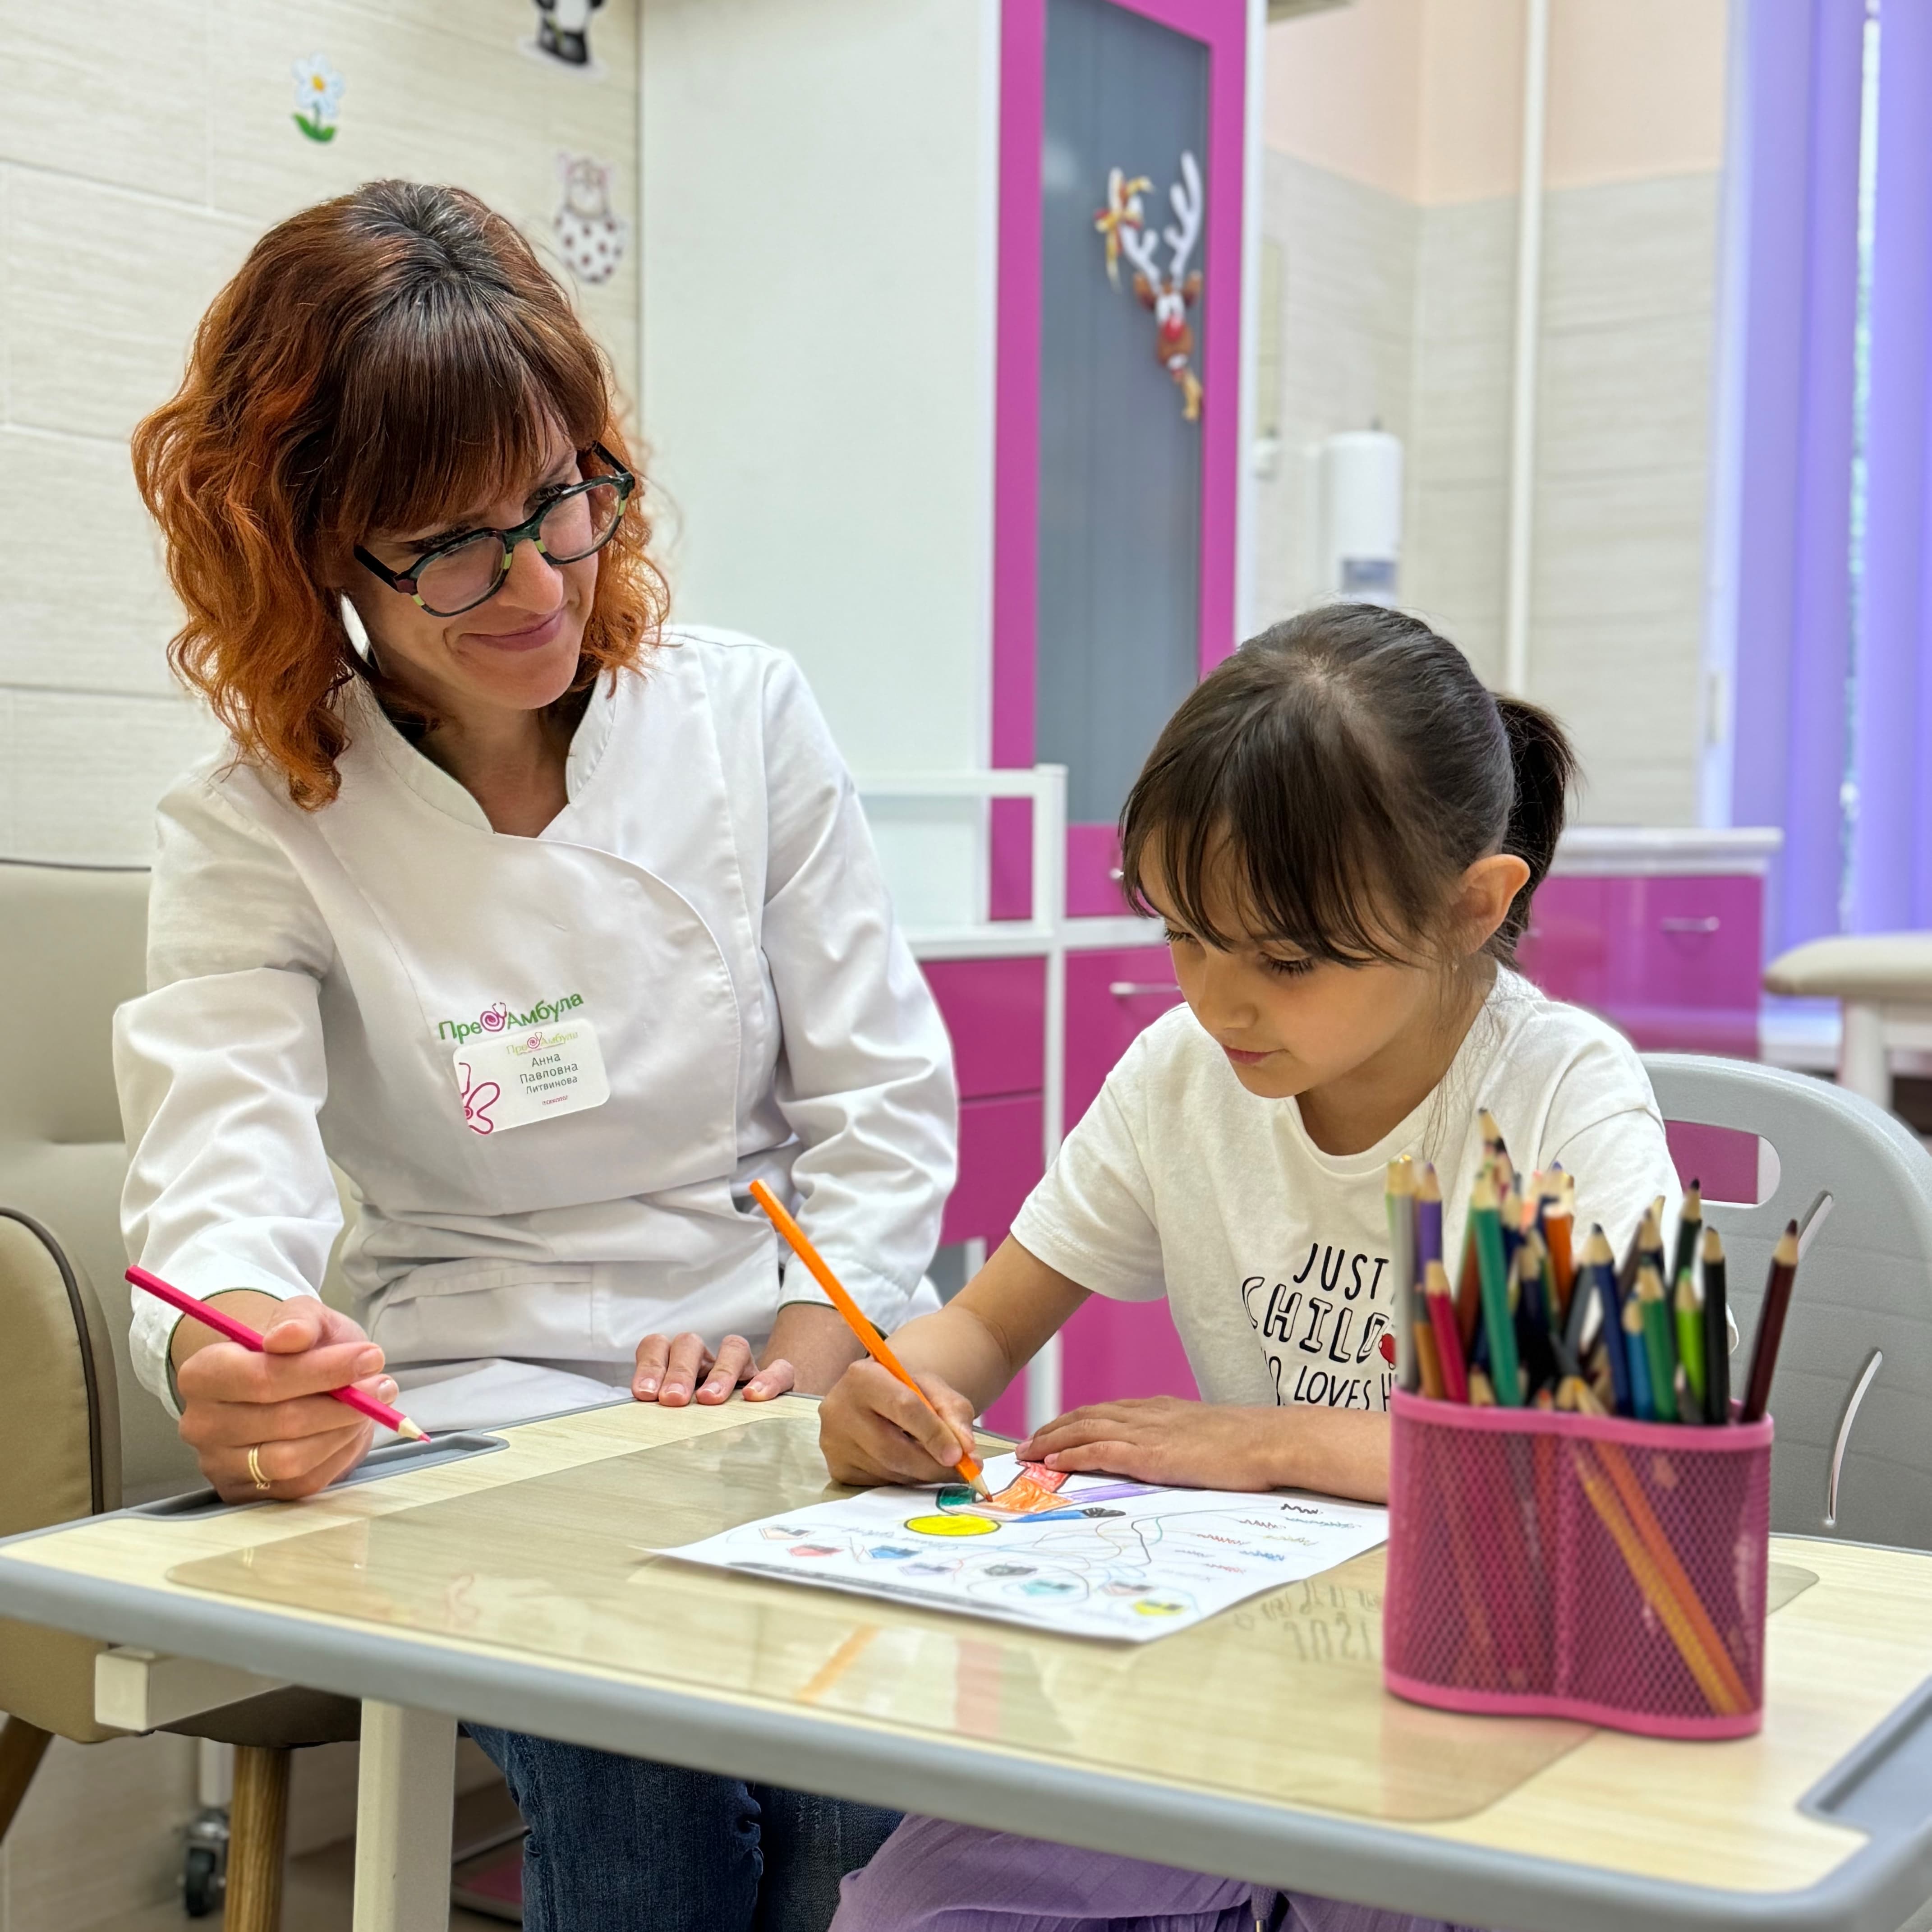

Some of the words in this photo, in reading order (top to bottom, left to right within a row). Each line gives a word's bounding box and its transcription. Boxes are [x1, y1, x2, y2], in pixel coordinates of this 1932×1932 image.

[532, 1053, 561, 1067] Анна
[520, 1062, 578, 1084] Павловна
[526, 1076, 578, 1095] Литвинова
[1293, 1243, 1389, 1300] JUST
[1294, 1365, 1371, 1411] LOVES
